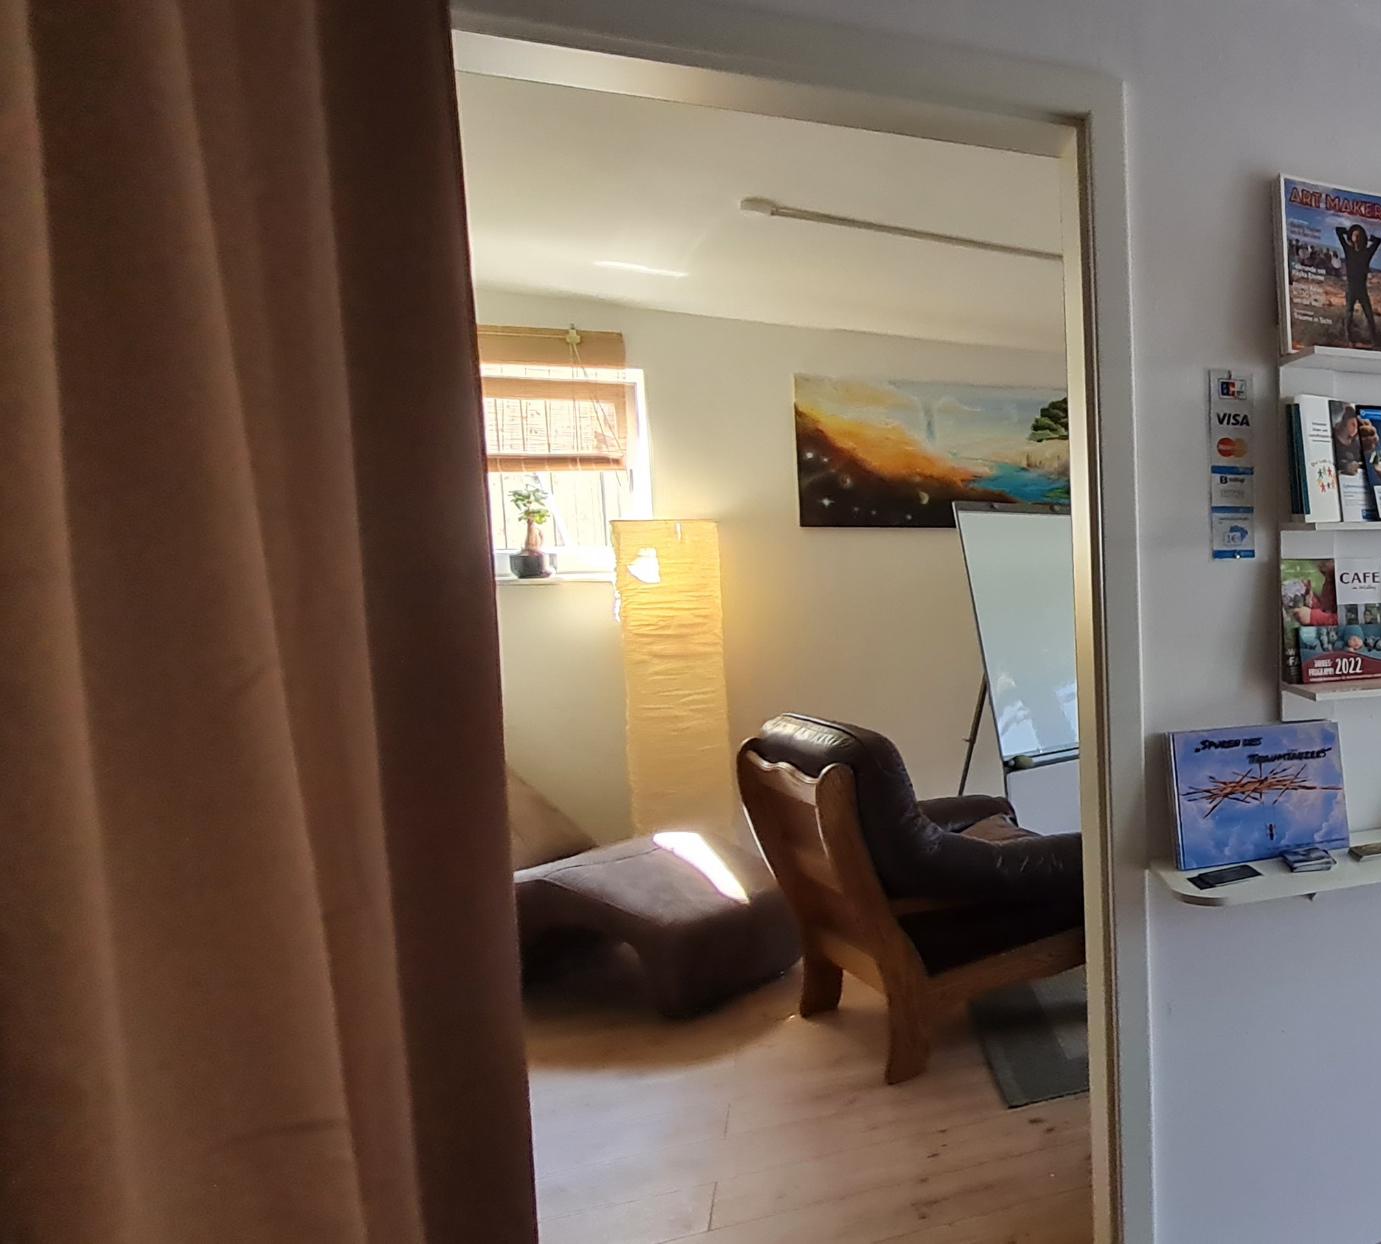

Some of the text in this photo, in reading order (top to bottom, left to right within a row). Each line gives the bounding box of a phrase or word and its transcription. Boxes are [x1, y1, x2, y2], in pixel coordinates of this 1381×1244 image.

[1289, 187, 1321, 209] ART
[1216, 412, 1250, 427] VISA
[1339, 572, 1381, 584] CAFE
[1335, 657, 1363, 675] 2022
